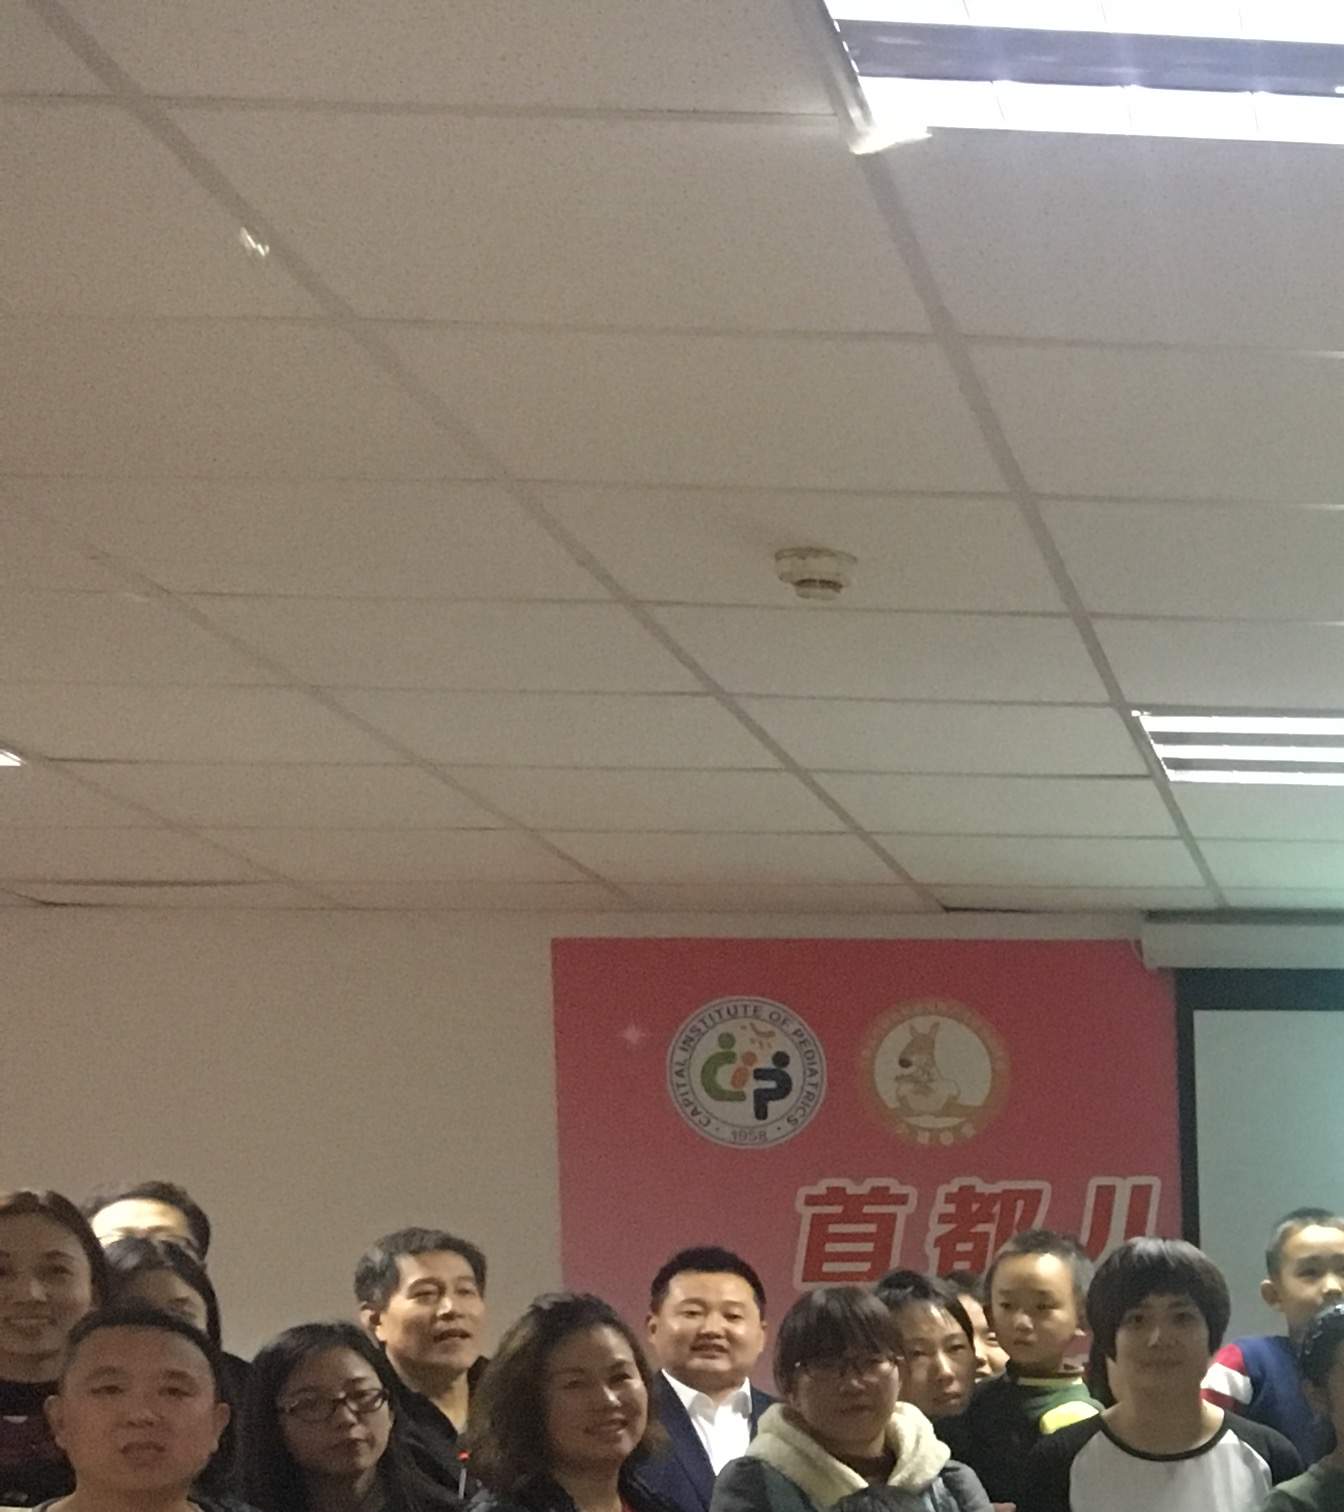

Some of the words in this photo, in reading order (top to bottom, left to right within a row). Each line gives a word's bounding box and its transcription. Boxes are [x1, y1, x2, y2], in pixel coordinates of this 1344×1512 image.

[679, 1003, 763, 1053] INSTITUTE
[768, 1010, 791, 1031] OF
[674, 1060, 712, 1127] CAPITAL
[786, 1027, 820, 1126] PEDIATRICS
